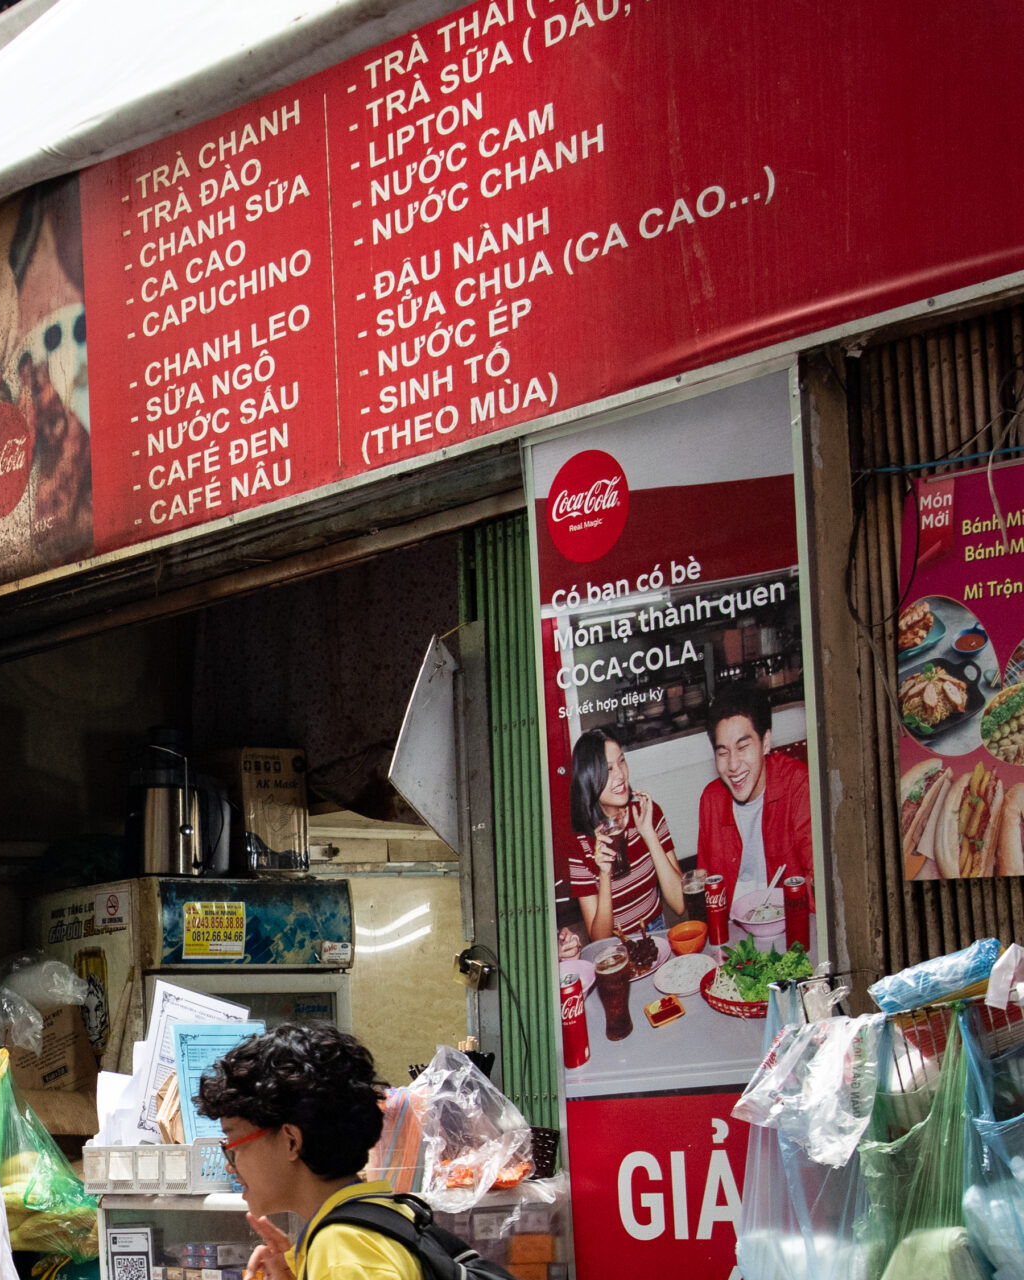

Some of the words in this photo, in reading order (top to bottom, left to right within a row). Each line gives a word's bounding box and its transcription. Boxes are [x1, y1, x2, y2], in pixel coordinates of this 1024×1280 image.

[364, 33, 429, 89] TRÀ
[365, 73, 430, 128] TRÀ
[440, 40, 514, 94] SỮA
[135, 150, 191, 199] TRÀ
[198, 99, 300, 169] CHANH
[368, 92, 483, 168] LIPTON
[371, 142, 468, 207] NƯỚC
[478, 102, 555, 158] CAM
[137, 186, 192, 234] TRÀ
[199, 158, 262, 207] ĐÀO
[372, 182, 469, 246] NƯỚC
[480, 123, 604, 198] CHANH
[139, 205, 236, 268] CHANH
[245, 174, 311, 222] SỮA
[376, 290, 446, 337] SỮA
[454, 250, 554, 307] CHUA
[563, 222, 629, 275] (CA
[638, 165, 775, 239] CAO...)
[452, 206, 550, 270] NÀNH
[141, 269, 179, 303] CA
[185, 239, 246, 284] CAO
[142, 249, 311, 337] CAPUCHINO
[144, 329, 241, 387] CHANH
[251, 304, 310, 349] LEO
[378, 318, 477, 377] NƯỚC
[488, 298, 532, 338] ÉP
[146, 382, 205, 422] SỮA
[212, 349, 275, 399] NGÔ
[378, 365, 453, 414] SINH
[463, 341, 510, 384] TỐ
[147, 408, 230, 456] NƯỚC
[239, 381, 299, 425] SẤU
[361, 405, 459, 465] (THEO
[470, 372, 558, 425] MÙA)
[148, 440, 221, 490] CAFÉ
[228, 423, 289, 466] ĐEN
[149, 475, 222, 525] CAFÉ
[230, 459, 291, 501] NÂU
[552, 476, 621, 522] Coca-Cola
[569, 523, 583, 532] Real
[583, 517, 603, 528] Magic
[919, 492, 953, 511] Món
[921, 510, 949, 530] Mới
[961, 514, 1003, 536] Bánh
[551, 584, 580, 611] Có
[586, 578, 629, 605] bạn
[636, 563, 664, 592] có
[670, 555, 701, 584] bè
[964, 542, 1005, 562] Bánh
[553, 624, 603, 653] Món
[610, 616, 632, 644] lạ
[638, 595, 711, 633] thành
[717, 581, 786, 618] quen
[964, 584, 983, 601] Mì
[987, 578, 1023, 598] Trộn
[556, 640, 698, 690] COCA-COLA
[577, 700, 594, 716] kết
[596, 696, 618, 714] hợp
[621, 691, 647, 708] diệu
[649, 687, 664, 704] kỳ
[617, 1117, 743, 1241] GIẢ
